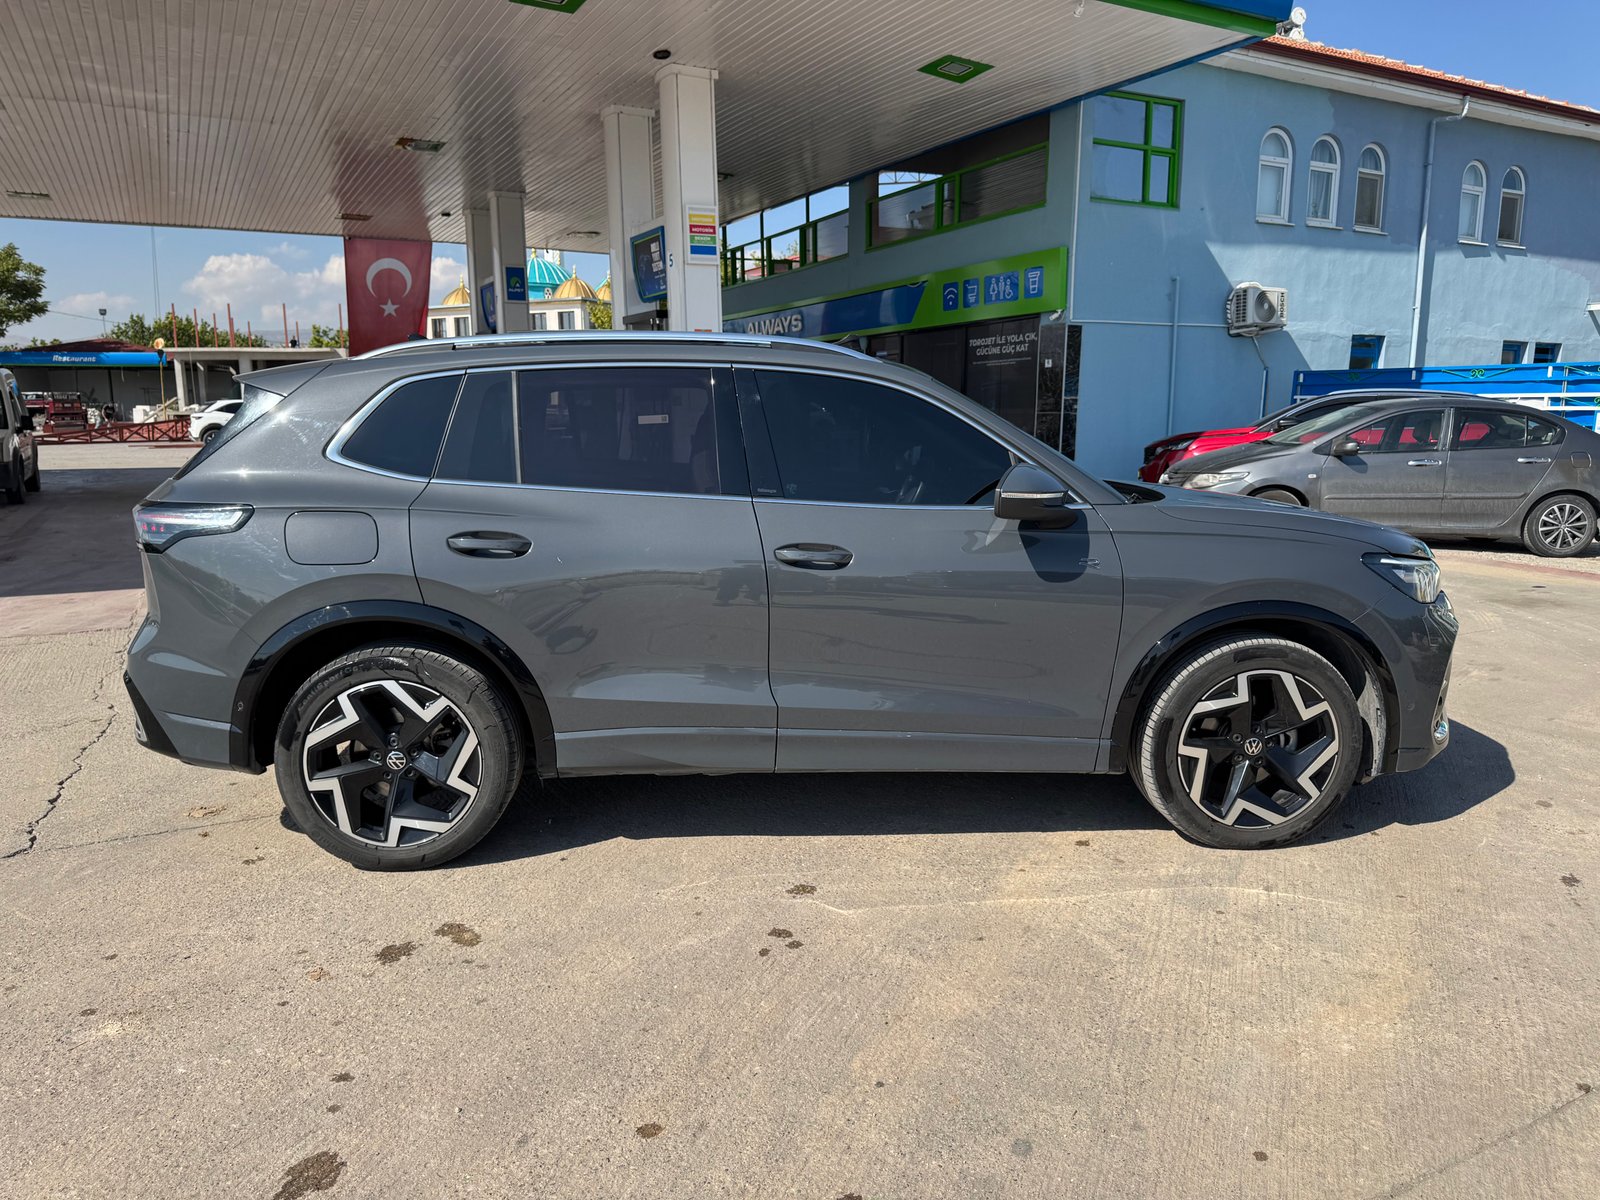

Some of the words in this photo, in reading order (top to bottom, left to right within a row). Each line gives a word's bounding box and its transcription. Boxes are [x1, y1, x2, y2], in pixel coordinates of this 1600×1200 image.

[669, 253, 674, 267] 5
[747, 314, 803, 336] ALWAYS
[996, 334, 1006, 344] İLE
[1007, 333, 1024, 343] YOLA
[976, 346, 1001, 356] GÜCÜNE
[1001, 344, 1015, 355] GÜÇ
[1016, 343, 1029, 352] KAT
